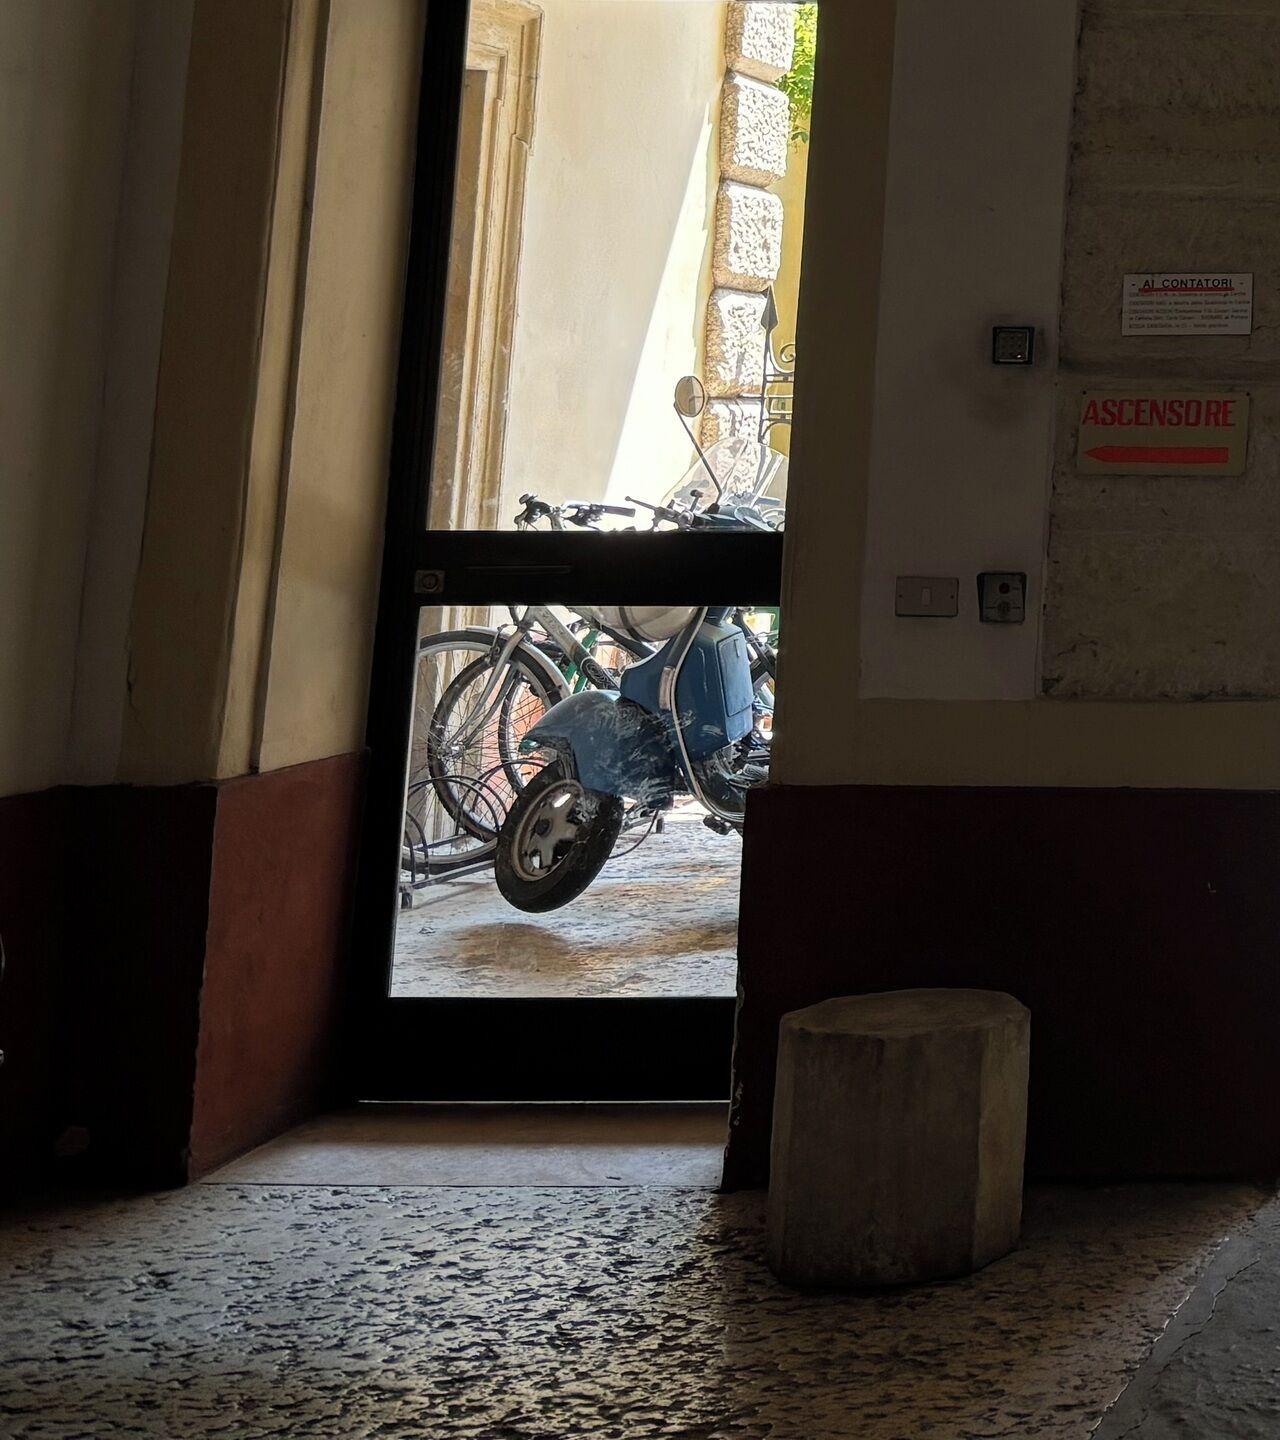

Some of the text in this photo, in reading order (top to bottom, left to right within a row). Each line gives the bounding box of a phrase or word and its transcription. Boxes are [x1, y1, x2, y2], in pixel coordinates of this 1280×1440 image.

[1143, 278, 1233, 289] AI CONTATORI
[1081, 399, 1237, 427] ASCENSORE
